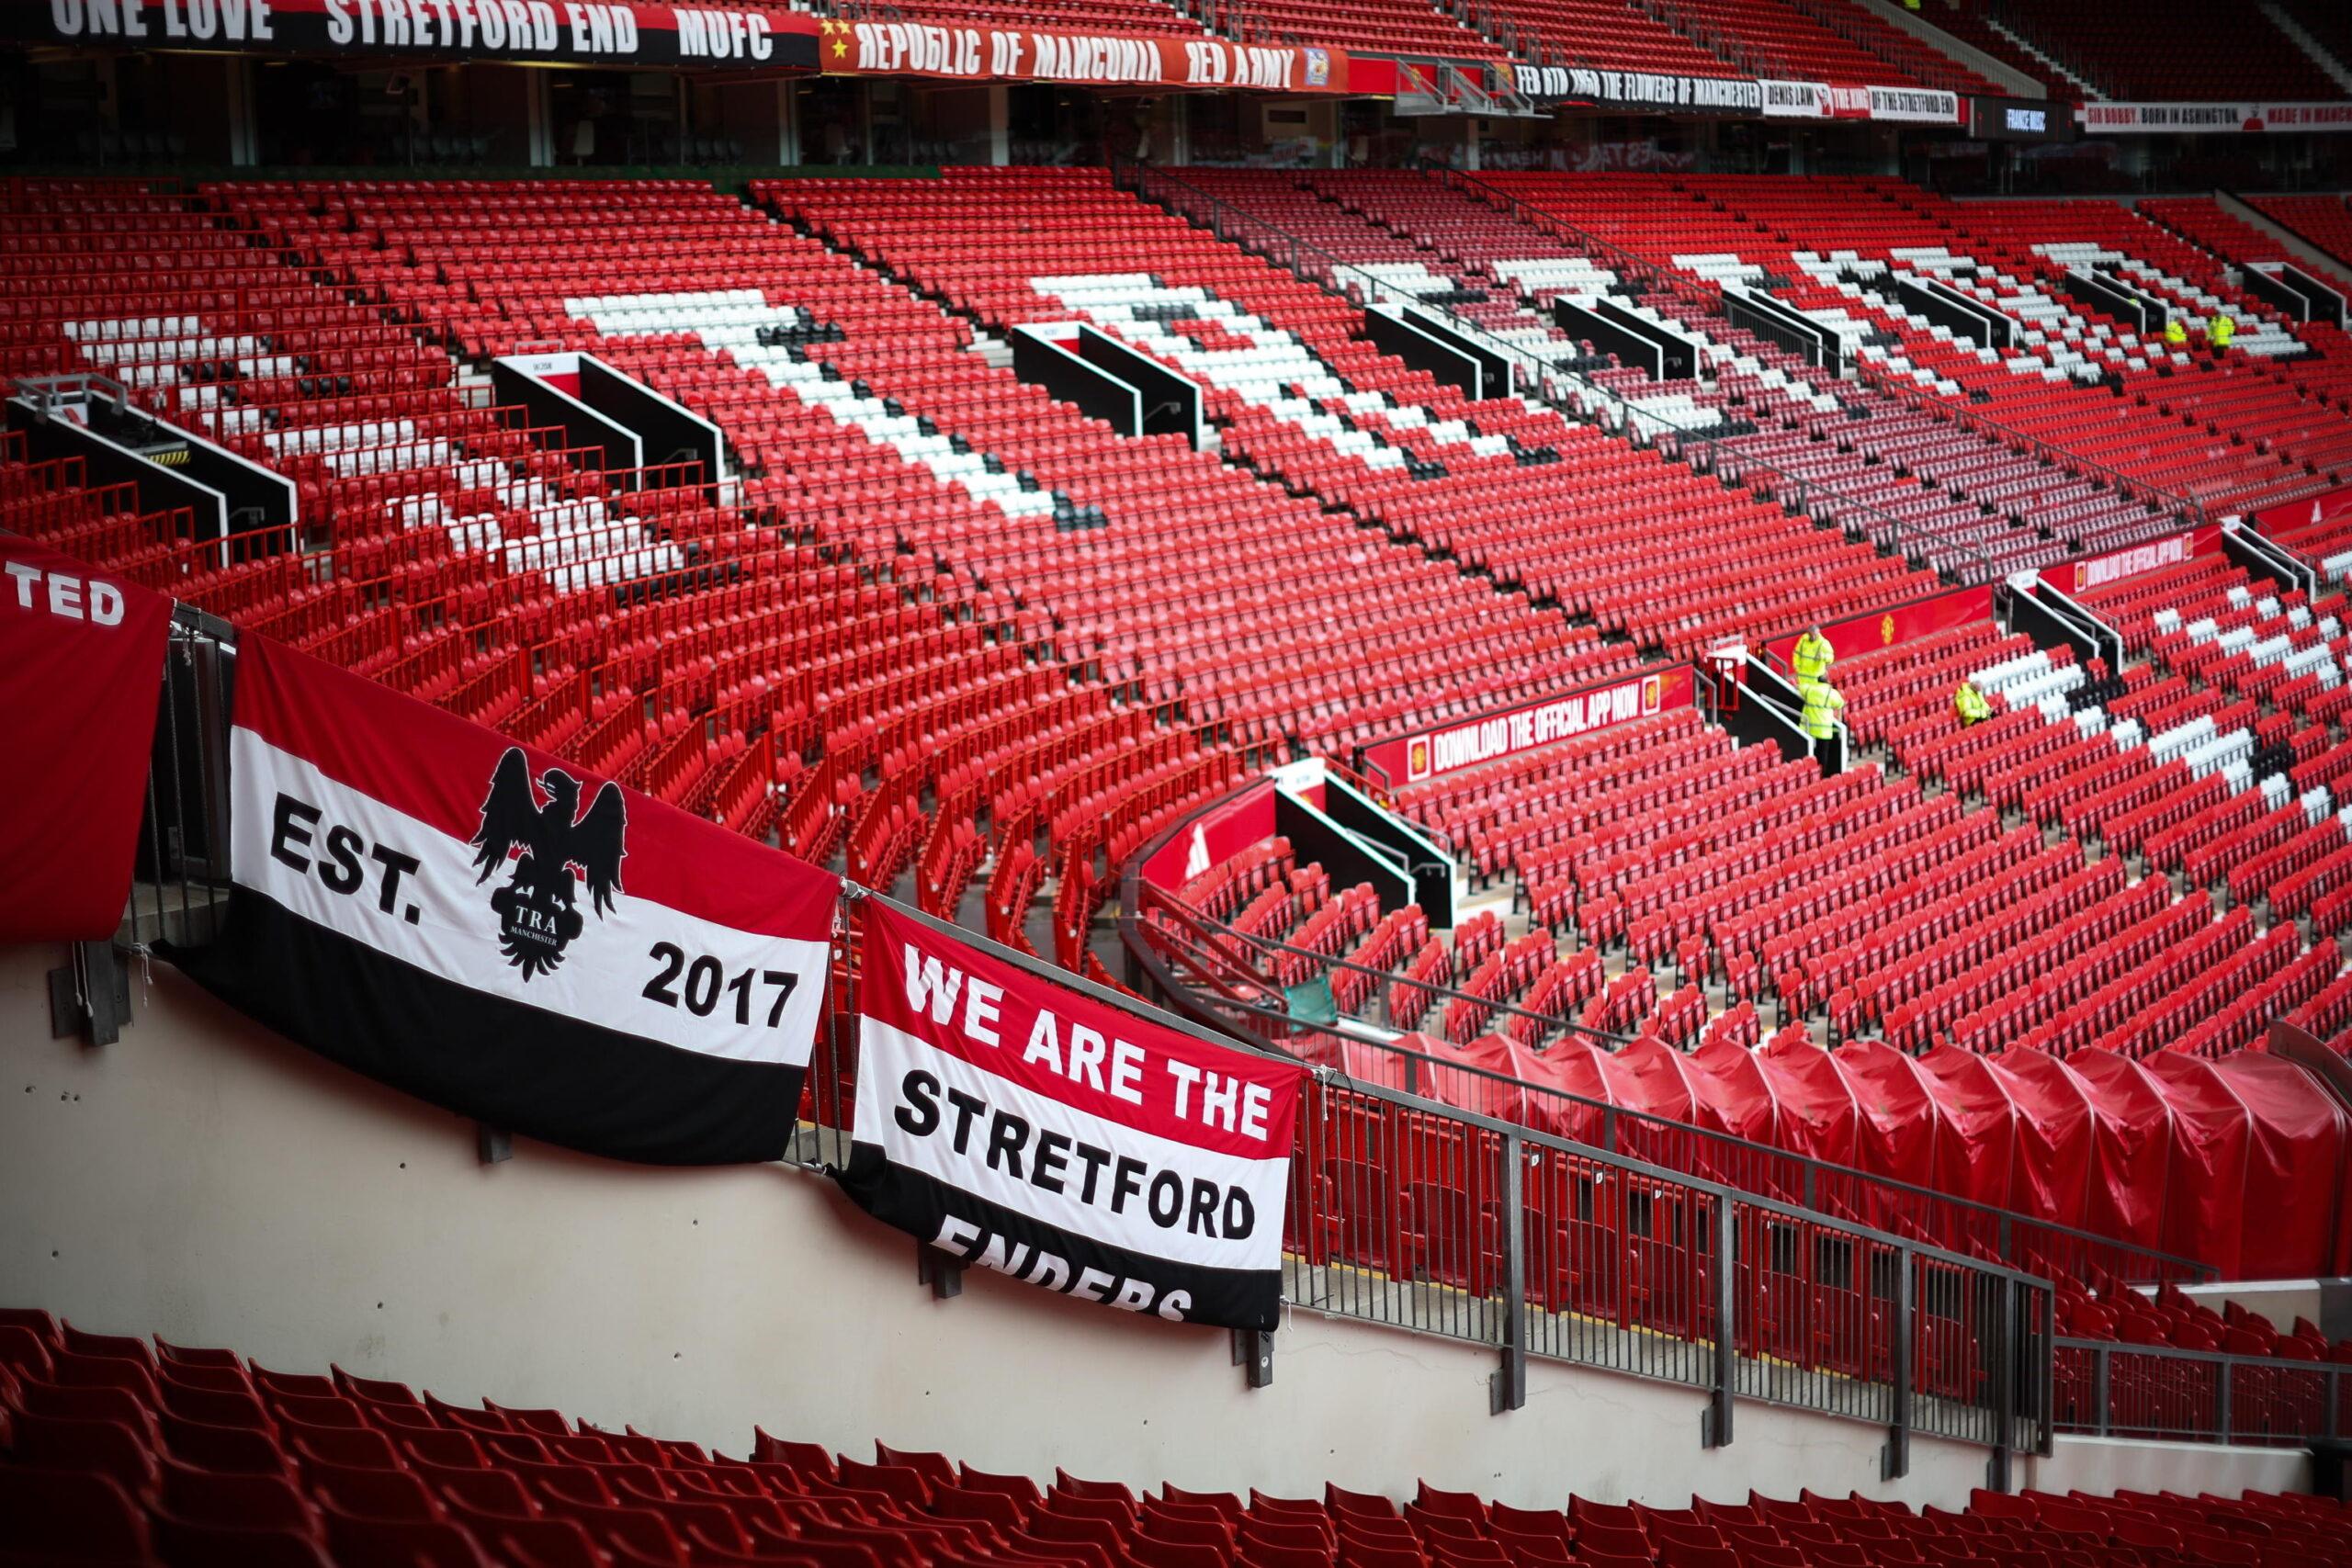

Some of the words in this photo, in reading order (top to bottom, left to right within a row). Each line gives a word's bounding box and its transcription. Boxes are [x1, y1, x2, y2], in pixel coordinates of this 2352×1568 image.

[51, 0, 147, 36] ONE
[164, 0, 274, 40] LOVE
[324, 0, 558, 51] STRETFORD
[564, 3, 639, 54] END
[673, 8, 773, 61] MUFC
[990, 30, 1023, 75] OF
[1515, 65, 1542, 95] FEB
[1542, 67, 1568, 96] 6TH
[1600, 72, 1623, 101] THE
[1624, 73, 1676, 104] FLOWERS
[1678, 77, 1691, 106] OF
[1693, 77, 1761, 107] MANCHESTER
[1769, 85, 1793, 106] DENIS
[1795, 86, 1815, 107] LAW
[1871, 91, 1882, 110] OF
[1883, 91, 1897, 111] THE
[1898, 92, 1940, 113] STRETFORD
[1940, 96, 1955, 114] END
[2087, 107, 2103, 124] SIR
[2142, 107, 2167, 124] BORN
[2169, 107, 2179, 124] IN
[2267, 107, 2298, 124] MADE
[6, 560, 125, 626] TED
[1434, 716, 1509, 773] DOWNLOAD
[1508, 709, 1534, 751] THE
[1534, 697, 1587, 743] OFFICIAL
[1588, 690, 1611, 728] APP
[1611, 682, 1639, 723] NOW
[270, 792, 421, 926] EST.
[510, 925, 558, 946] MANCHESTER
[515, 905, 557, 935] TRA
[642, 942, 798, 1029] 2017
[904, 942, 1005, 1048] WE
[1023, 1009, 1146, 1106] ARE
[1167, 1057, 1272, 1142] THE
[894, 1069, 1255, 1241] STRETFORD
